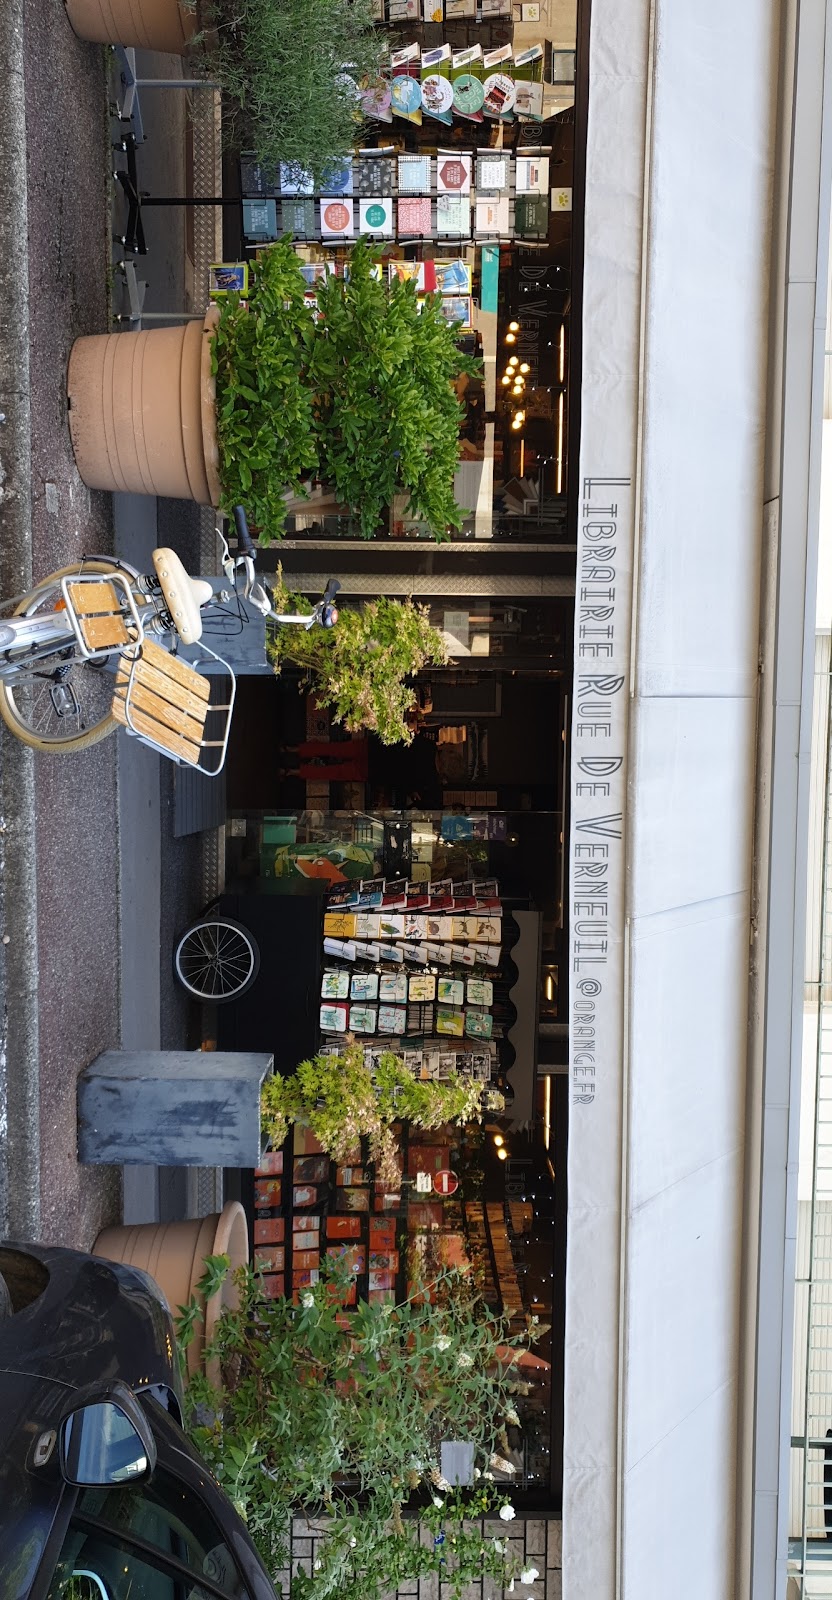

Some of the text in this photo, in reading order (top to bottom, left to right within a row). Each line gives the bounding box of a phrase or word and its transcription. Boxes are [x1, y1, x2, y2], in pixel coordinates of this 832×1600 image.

[517, 300, 548, 395] VERNEUI
[578, 477, 631, 658] LIBRAIRIE
[576, 674, 625, 738] RUE
[575, 756, 624, 797] DE
